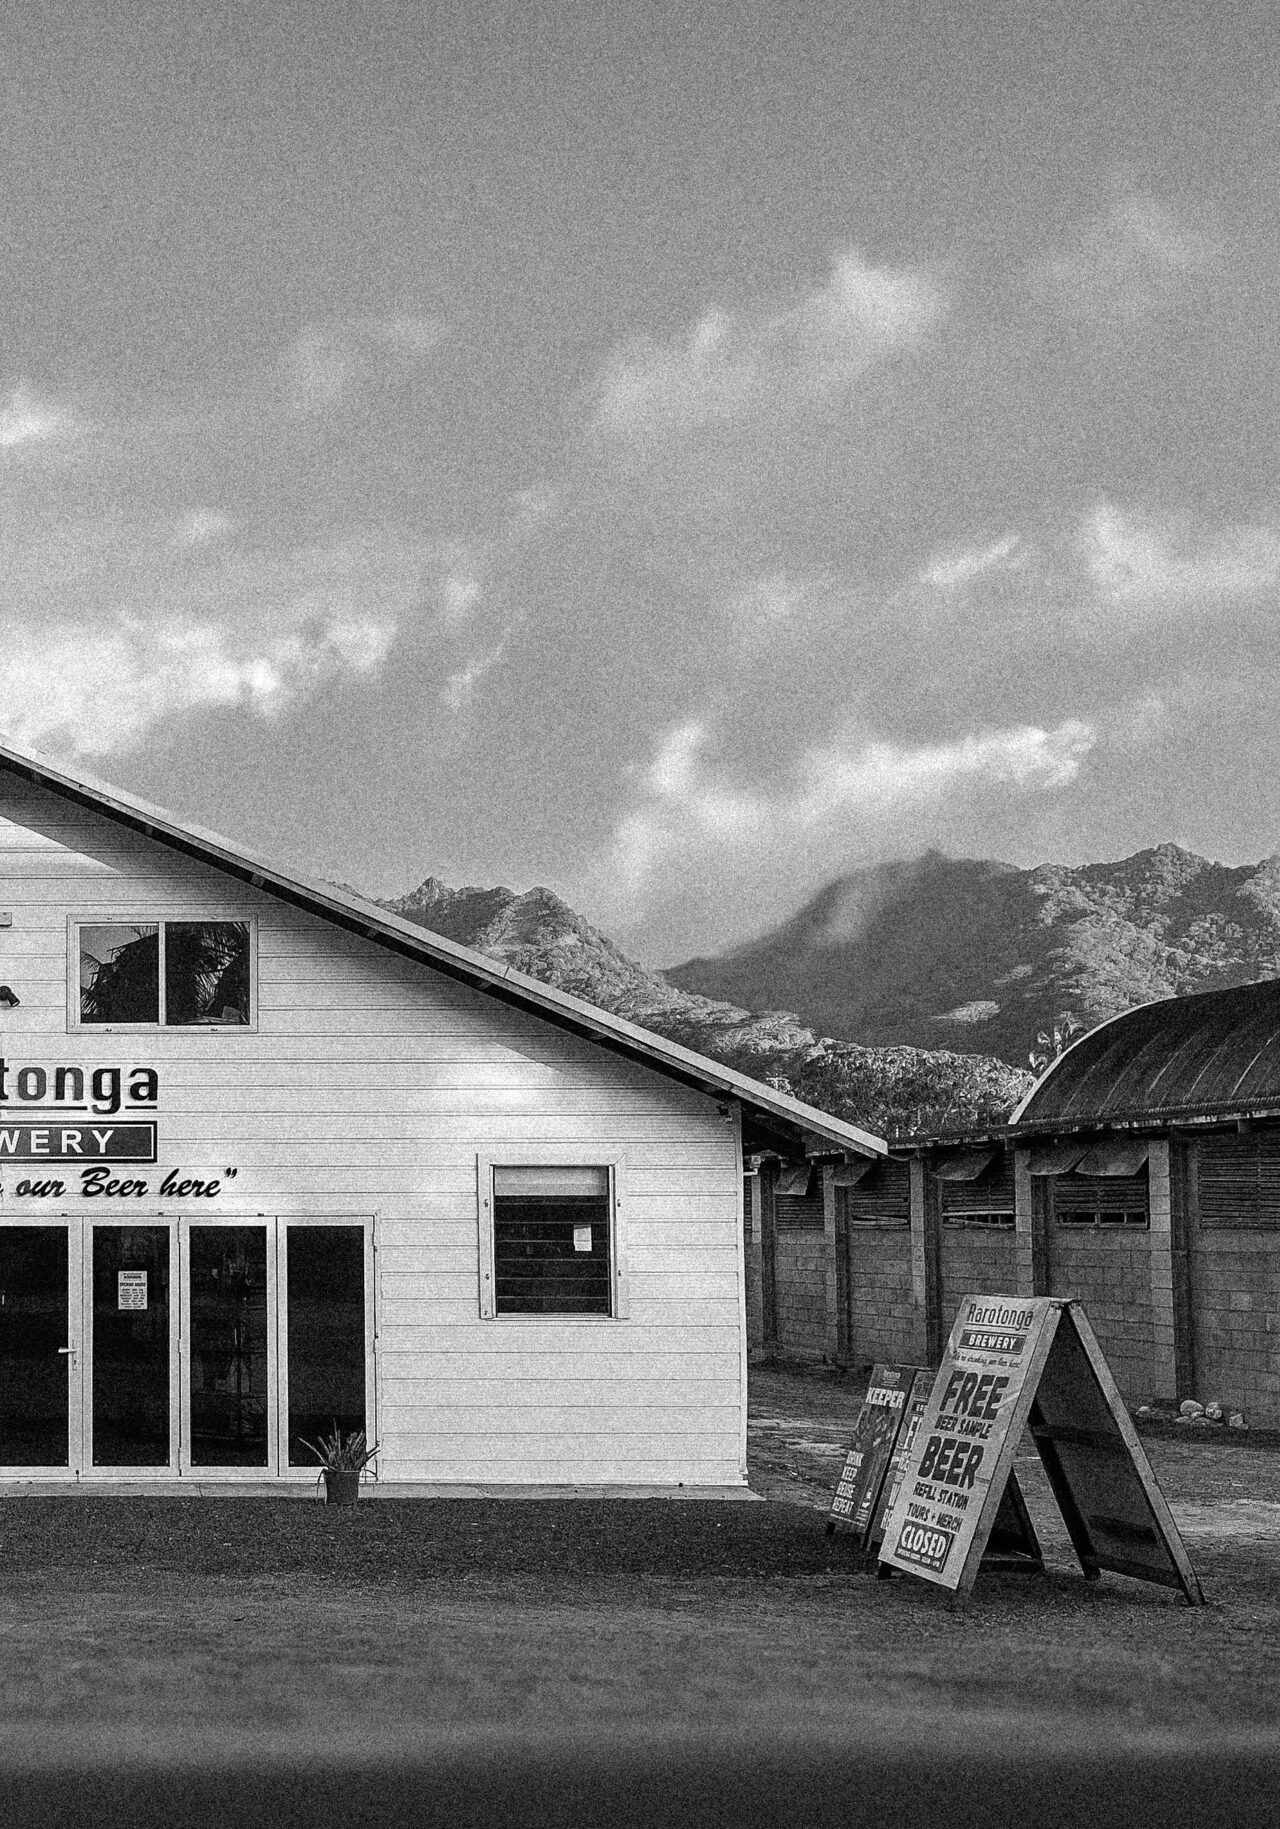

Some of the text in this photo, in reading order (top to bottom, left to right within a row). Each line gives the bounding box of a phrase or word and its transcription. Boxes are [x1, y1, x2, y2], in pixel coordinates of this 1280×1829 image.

[16, 1178, 66, 1198] our
[81, 1166, 148, 1198] Beer
[967, 1303, 1034, 1331] Rarotonga
[968, 1334, 1017, 1350] BREWERY
[865, 1387, 905, 1409] KEEPER
[939, 1370, 1010, 1420] FREE
[934, 1414, 959, 1432] BEER
[958, 1418, 994, 1440] SAMPLE
[917, 1435, 985, 1490] BEER
[913, 1481, 938, 1502] REFILL
[938, 1489, 970, 1511] STATION
[907, 1502, 930, 1522] TOURS
[901, 1525, 946, 1558] CLOSED
